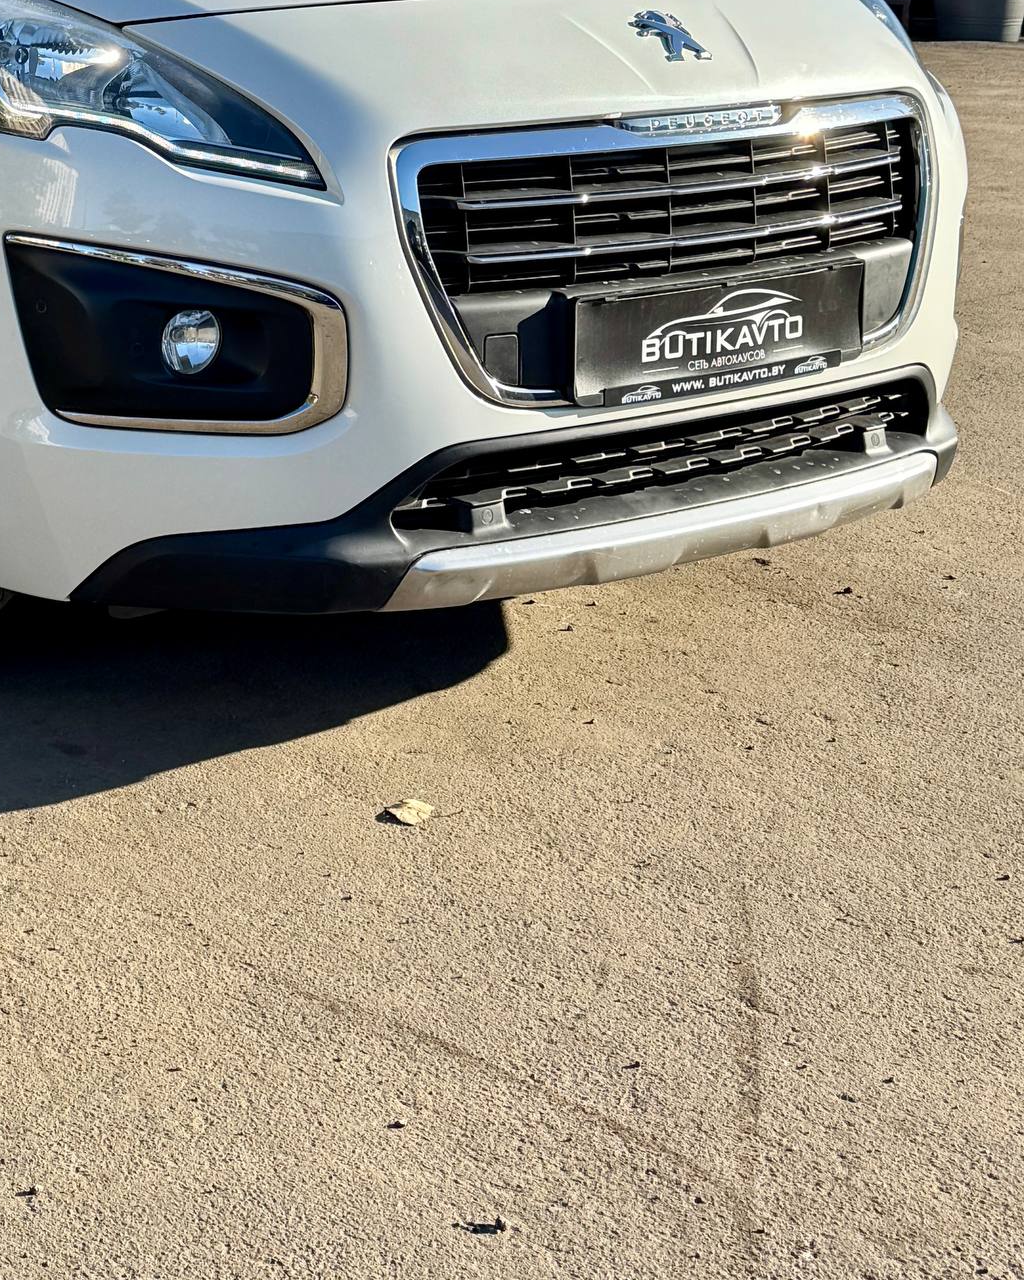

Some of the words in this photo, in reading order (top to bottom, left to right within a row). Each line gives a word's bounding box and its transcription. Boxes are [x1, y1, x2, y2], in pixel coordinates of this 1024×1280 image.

[649, 109, 765, 132] PEUGEOT
[641, 315, 804, 363] BUTIKAVTO
[687, 359, 709, 371] СЕТЬ
[710, 350, 766, 368] АВТОХАУСОВ
[794, 361, 828, 375] BUTIKAVTO
[709, 364, 786, 388] BUTIKAVTO.BY
[621, 391, 662, 404] BUTIKAVTO
